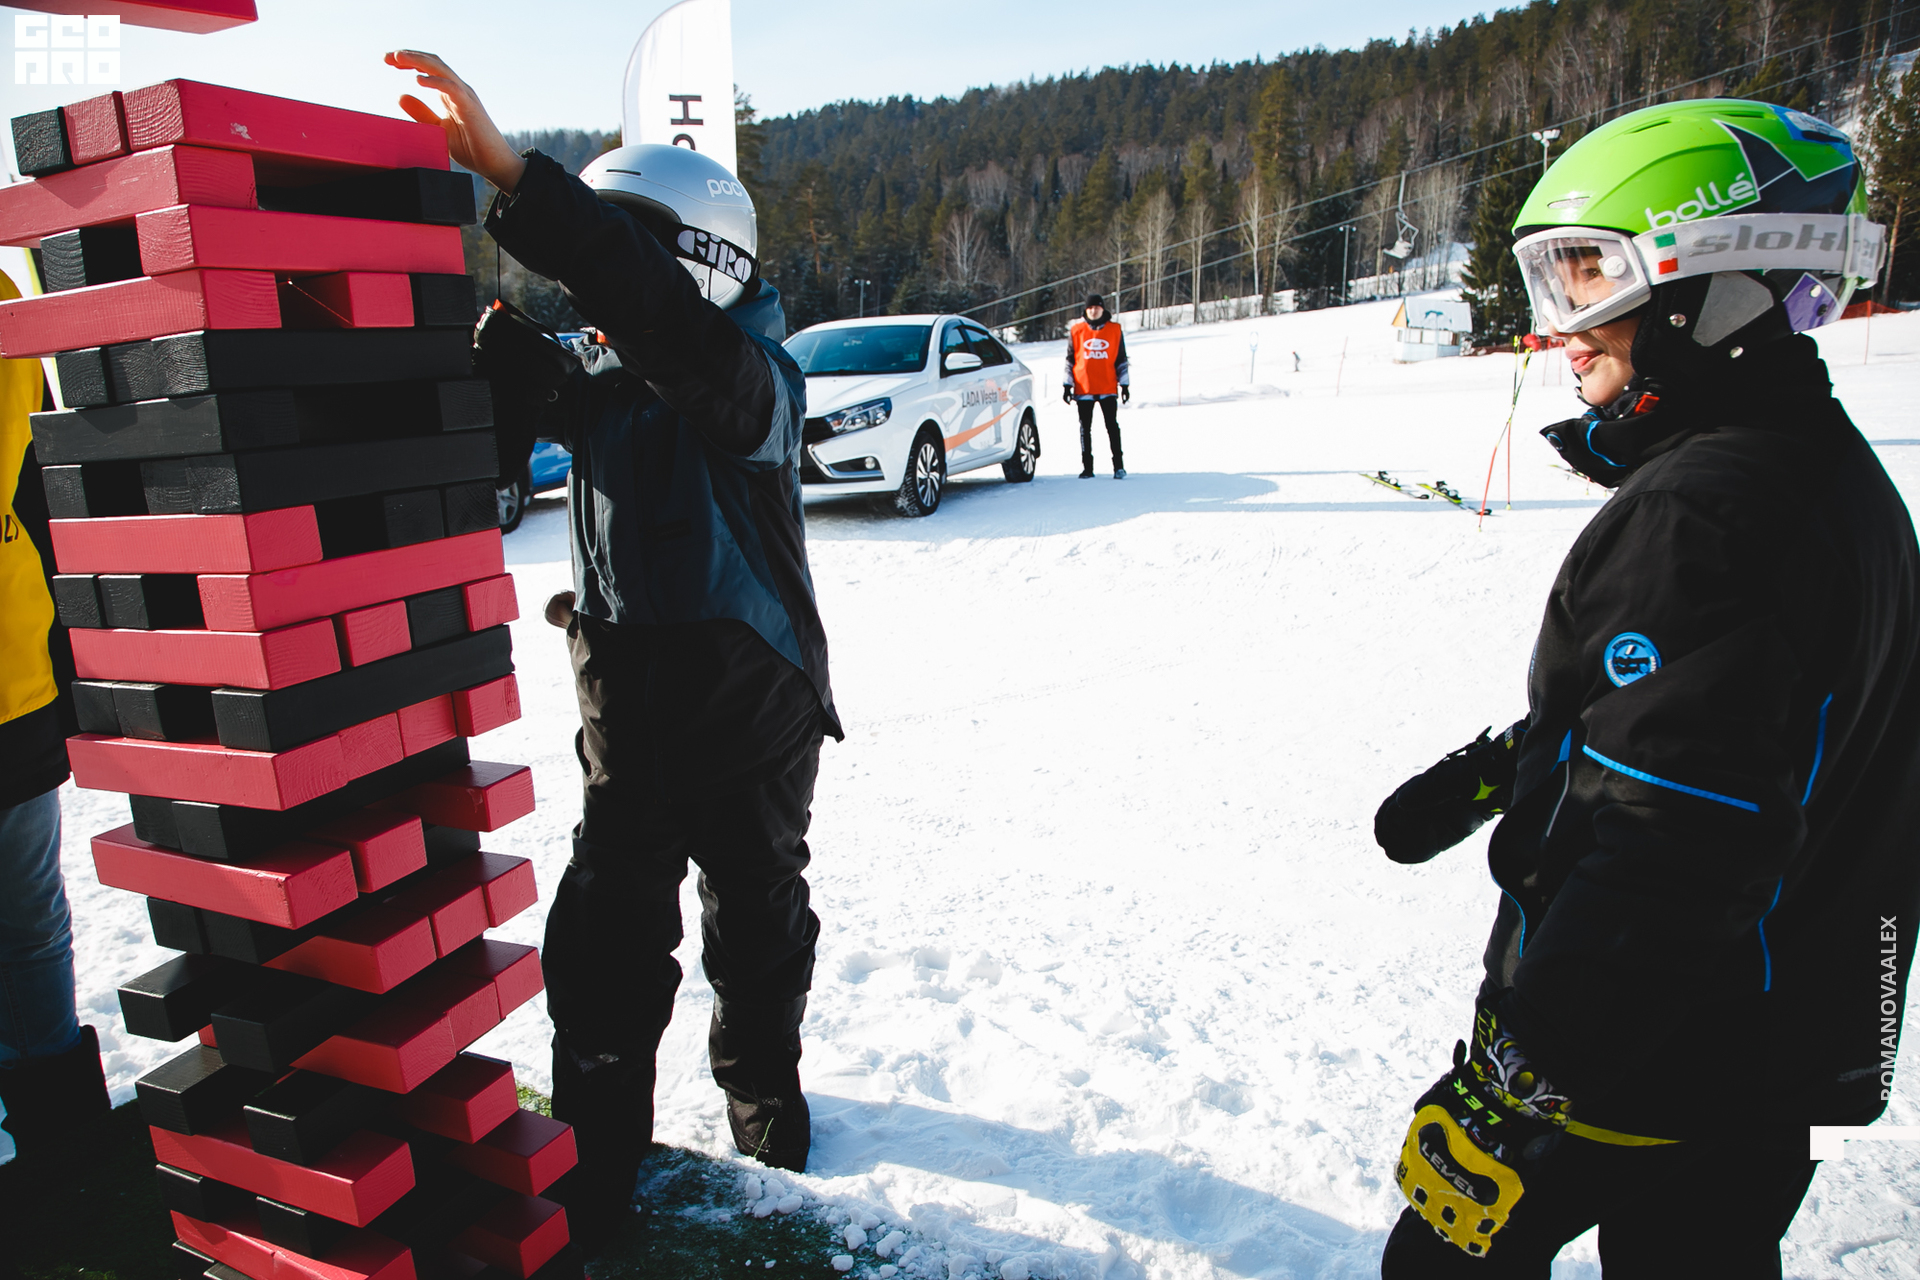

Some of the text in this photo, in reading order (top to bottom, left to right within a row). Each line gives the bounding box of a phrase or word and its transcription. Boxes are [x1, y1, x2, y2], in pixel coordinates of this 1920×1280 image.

[1083, 351, 1109, 360] LADA
[962, 391, 980, 408] LADA
[980, 389, 998, 405] Vesta
[1421, 1142, 1478, 1200] LEVEL
